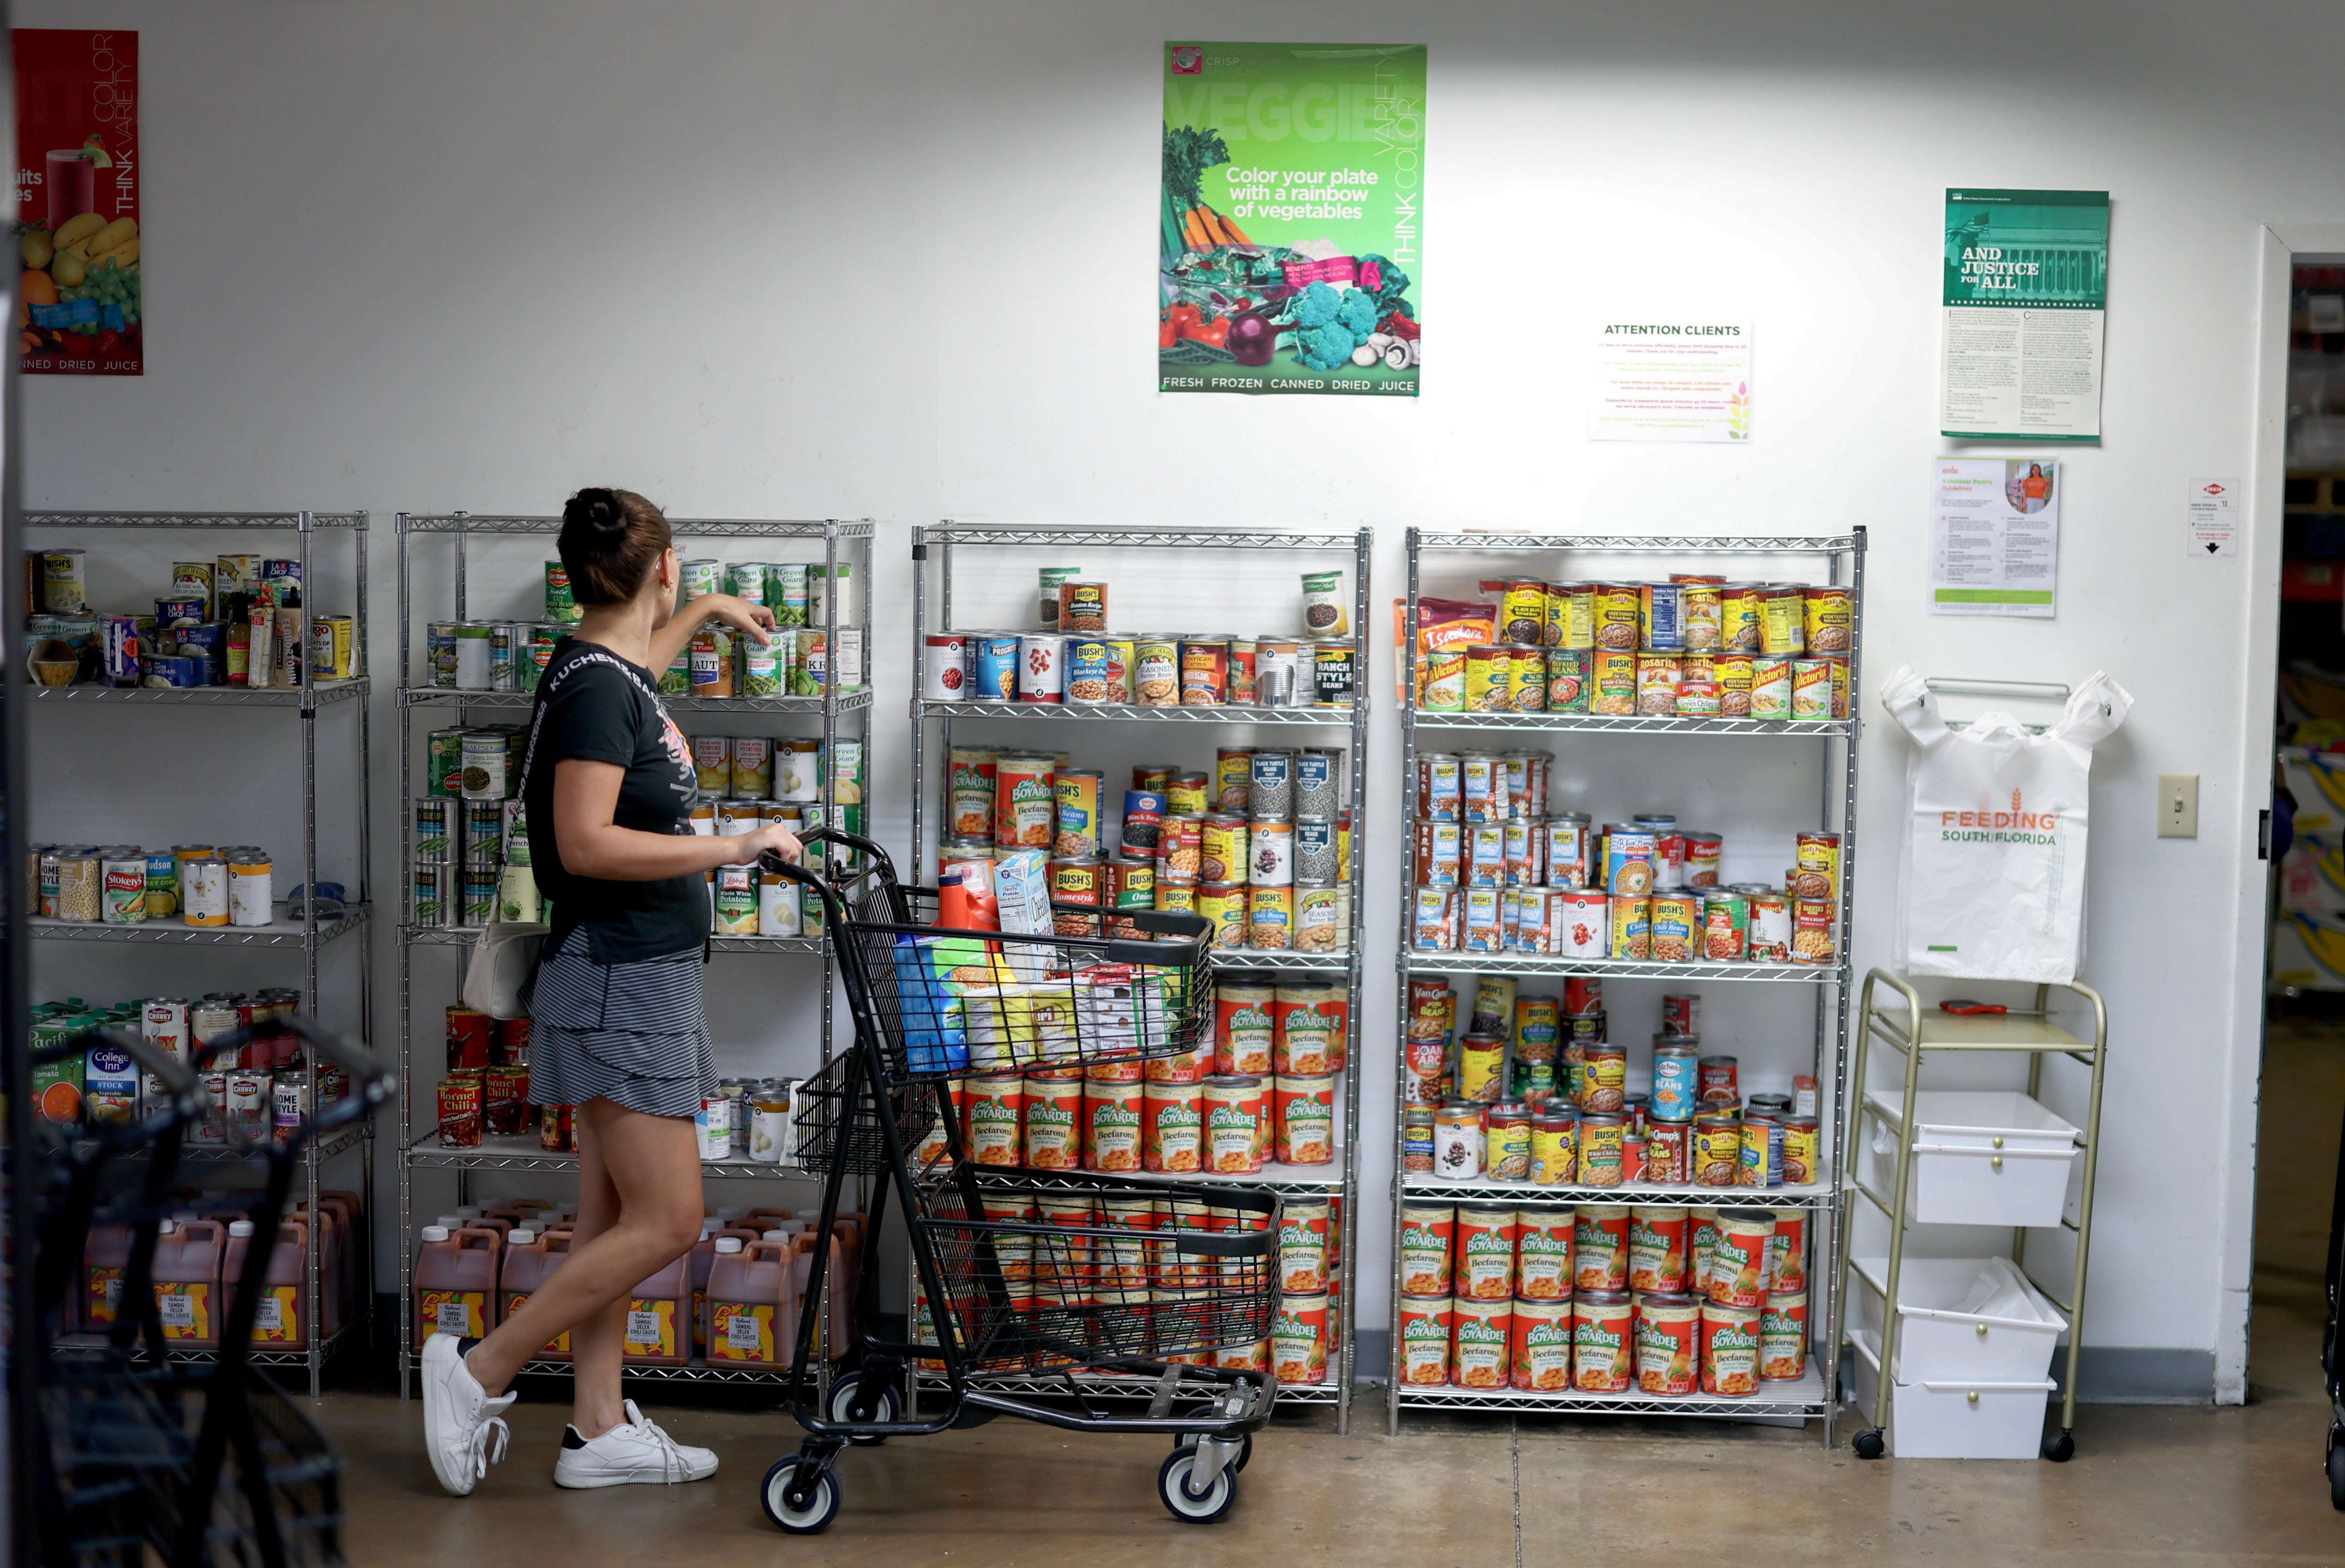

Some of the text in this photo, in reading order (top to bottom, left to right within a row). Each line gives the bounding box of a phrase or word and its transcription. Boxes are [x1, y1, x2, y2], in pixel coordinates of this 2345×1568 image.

[1206, 58, 1240, 66] CRISP
[93, 33, 113, 122] COLOR
[1374, 49, 1396, 156] VARIETY
[1165, 82, 1425, 142] VEGGIES
[115, 59, 133, 214] THINK VARIETY
[1226, 167, 1378, 187] Color your plate
[1394, 99, 1418, 264] THINK COLOR
[1230, 184, 1369, 202] with a rainbow
[1234, 202, 1362, 221] of vegetables
[1962, 247, 2002, 260] AND
[1961, 262, 2039, 276] JUSTICE
[1981, 276, 2016, 289] ALL
[1605, 325, 1740, 336] ATTENTION CLIENTS
[59, 360, 137, 370] DRIED JUICE
[1163, 377, 1415, 391] FRESH FROZEN CANNED DRIED JUICE
[1076, 589, 1097, 598] BUSH'S
[61, 625, 86, 634] Green
[1425, 623, 1483, 651] Isadora
[1078, 646, 1104, 656] BUSH'S
[1318, 662, 1349, 672] RANCH
[1434, 659, 1464, 680] Victoria
[1641, 658, 1677, 670] Rosarita
[1184, 671, 1209, 681] PINTO BEANS
[1316, 672, 1352, 682] STYLE
[1755, 667, 1787, 686] Victoria
[1018, 805, 1051, 814] Beefaroni
[1942, 811, 2056, 829] FEEDING
[1943, 830, 2056, 845] SOUTH FLORIDA
[107, 874, 142, 886] Stokely's
[726, 875, 745, 885] Libby's
[1059, 874, 1090, 885] BUSH'S
[1054, 892, 1094, 902] Homestyle
[1256, 893, 1282, 903] BUSH'S
[1657, 904, 1684, 914] BUSH'S
[1253, 912, 1266, 920] Chili
[1235, 1008, 1252, 1017] Chef
[1421, 1006, 1445, 1015] BEANS
[1528, 1009, 1553, 1017] BUSH'S
[148, 1012, 171, 1021] CHUNKY
[1230, 1015, 1274, 1028] BOYARDEE
[1414, 1046, 1442, 1055] JOAN
[95, 1052, 129, 1063] College
[1418, 1055, 1441, 1065] ARC
[104, 1061, 120, 1070] Inn
[234, 1084, 257, 1093] CHUNKY
[1656, 1079, 1682, 1090] BEANS
[440, 1091, 475, 1100] Hormel
[444, 1101, 469, 1110] Chili
[1209, 1114, 1256, 1126] BOYARDEE
[1595, 1131, 1619, 1140] BUSH'S
[1472, 1233, 1487, 1241] Chef
[1467, 1240, 1513, 1252] BOYARDEE
[1462, 1318, 1476, 1329] Chef
[1459, 1330, 1505, 1342] BOYARDEE
[1712, 1335, 1758, 1347] BOYARDEE
